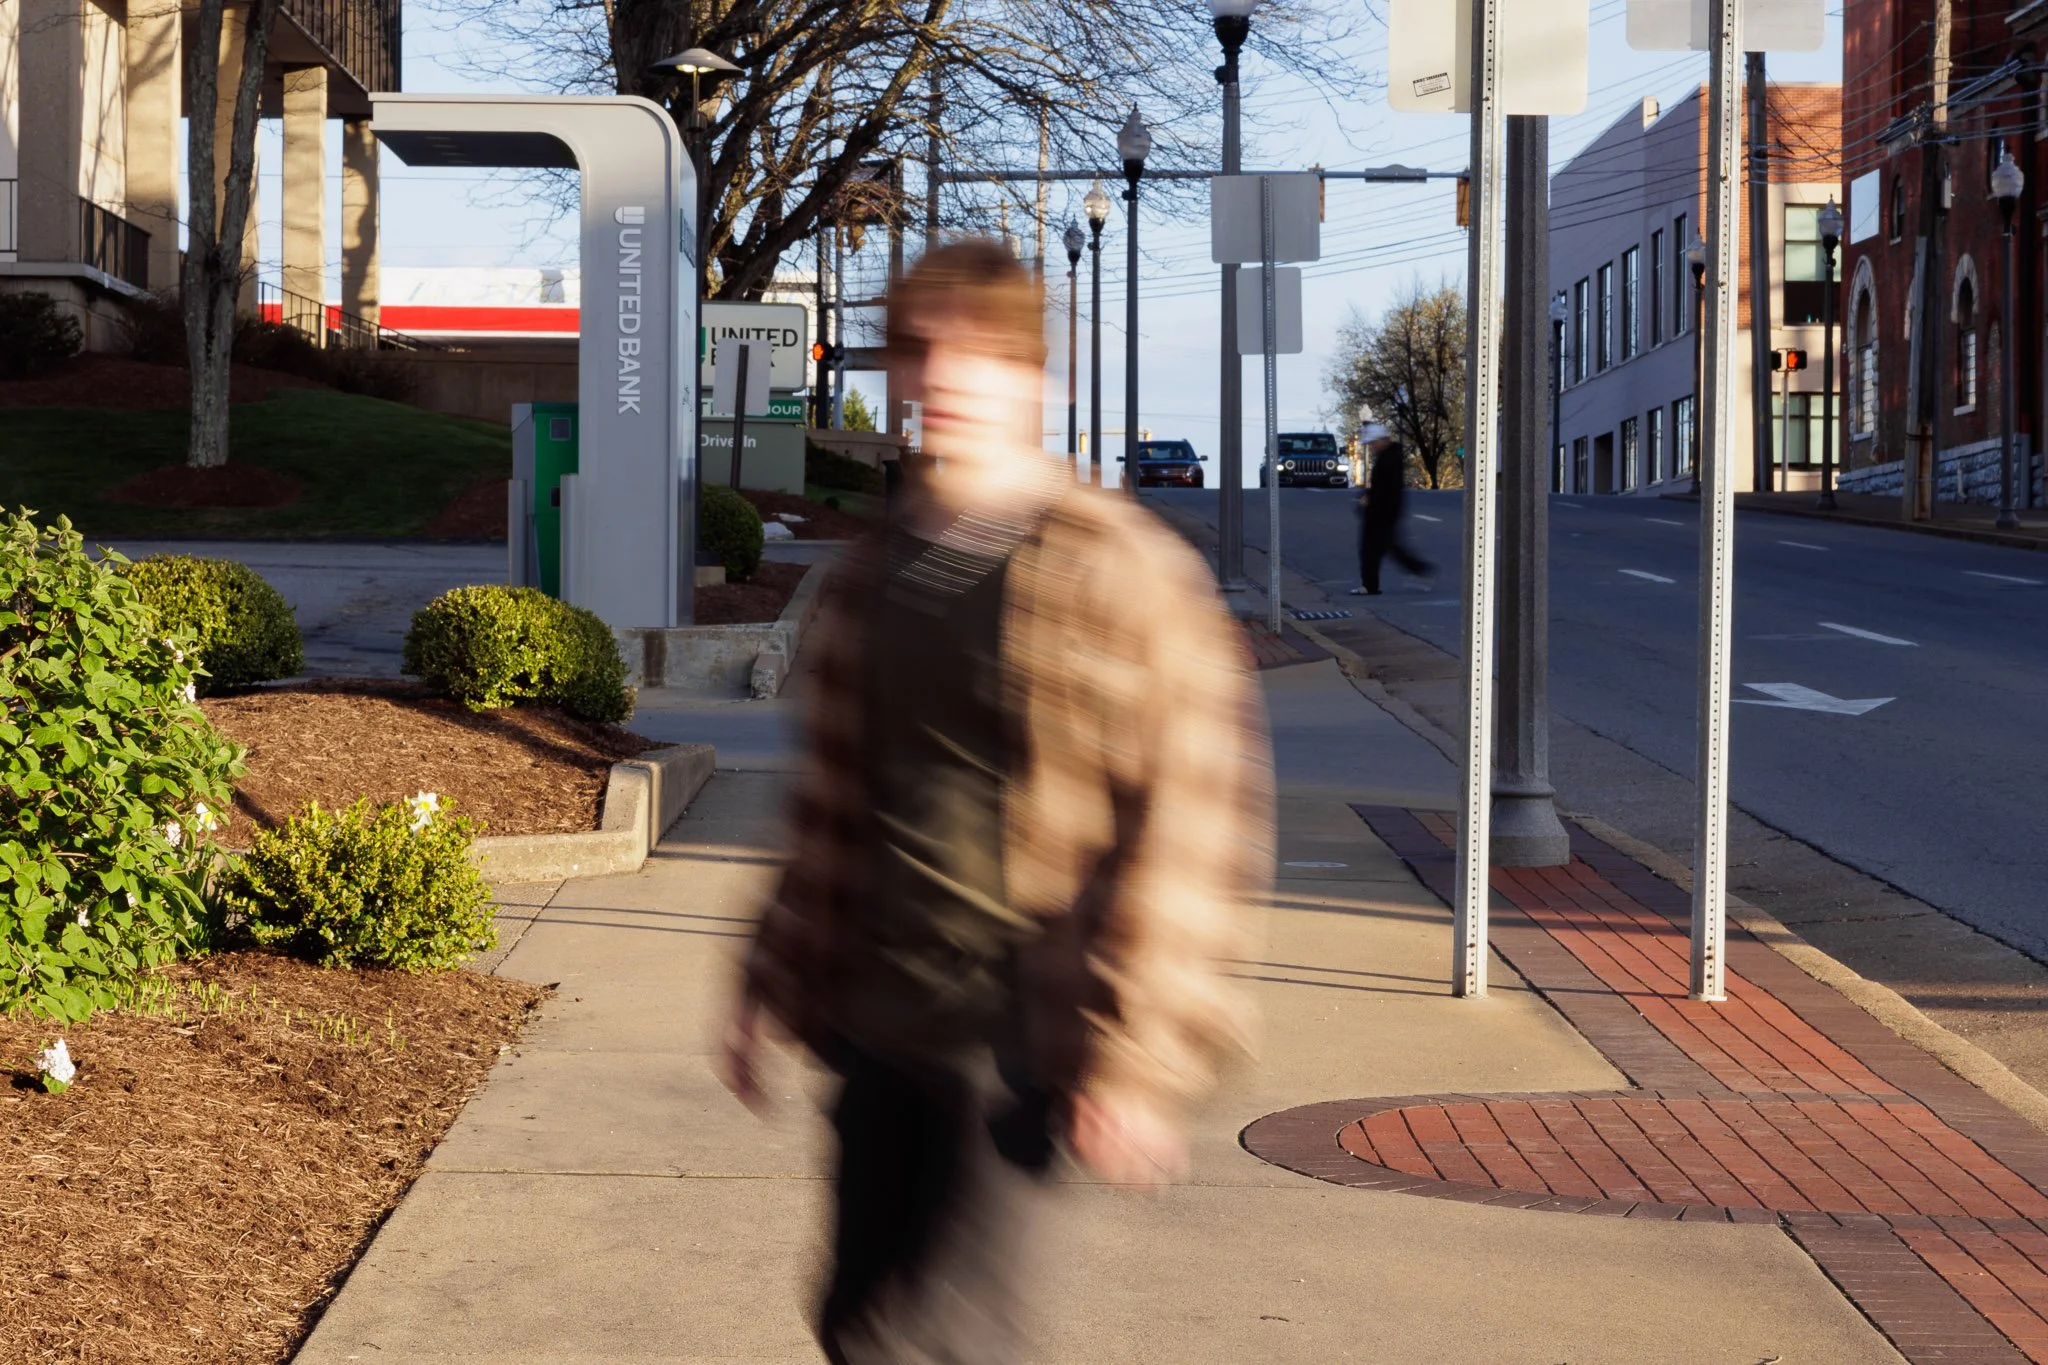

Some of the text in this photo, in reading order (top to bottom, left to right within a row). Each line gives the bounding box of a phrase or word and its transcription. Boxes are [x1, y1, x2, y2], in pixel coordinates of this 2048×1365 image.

[618, 228, 642, 415] UNITED BANK
[711, 327, 798, 347] UNITED
